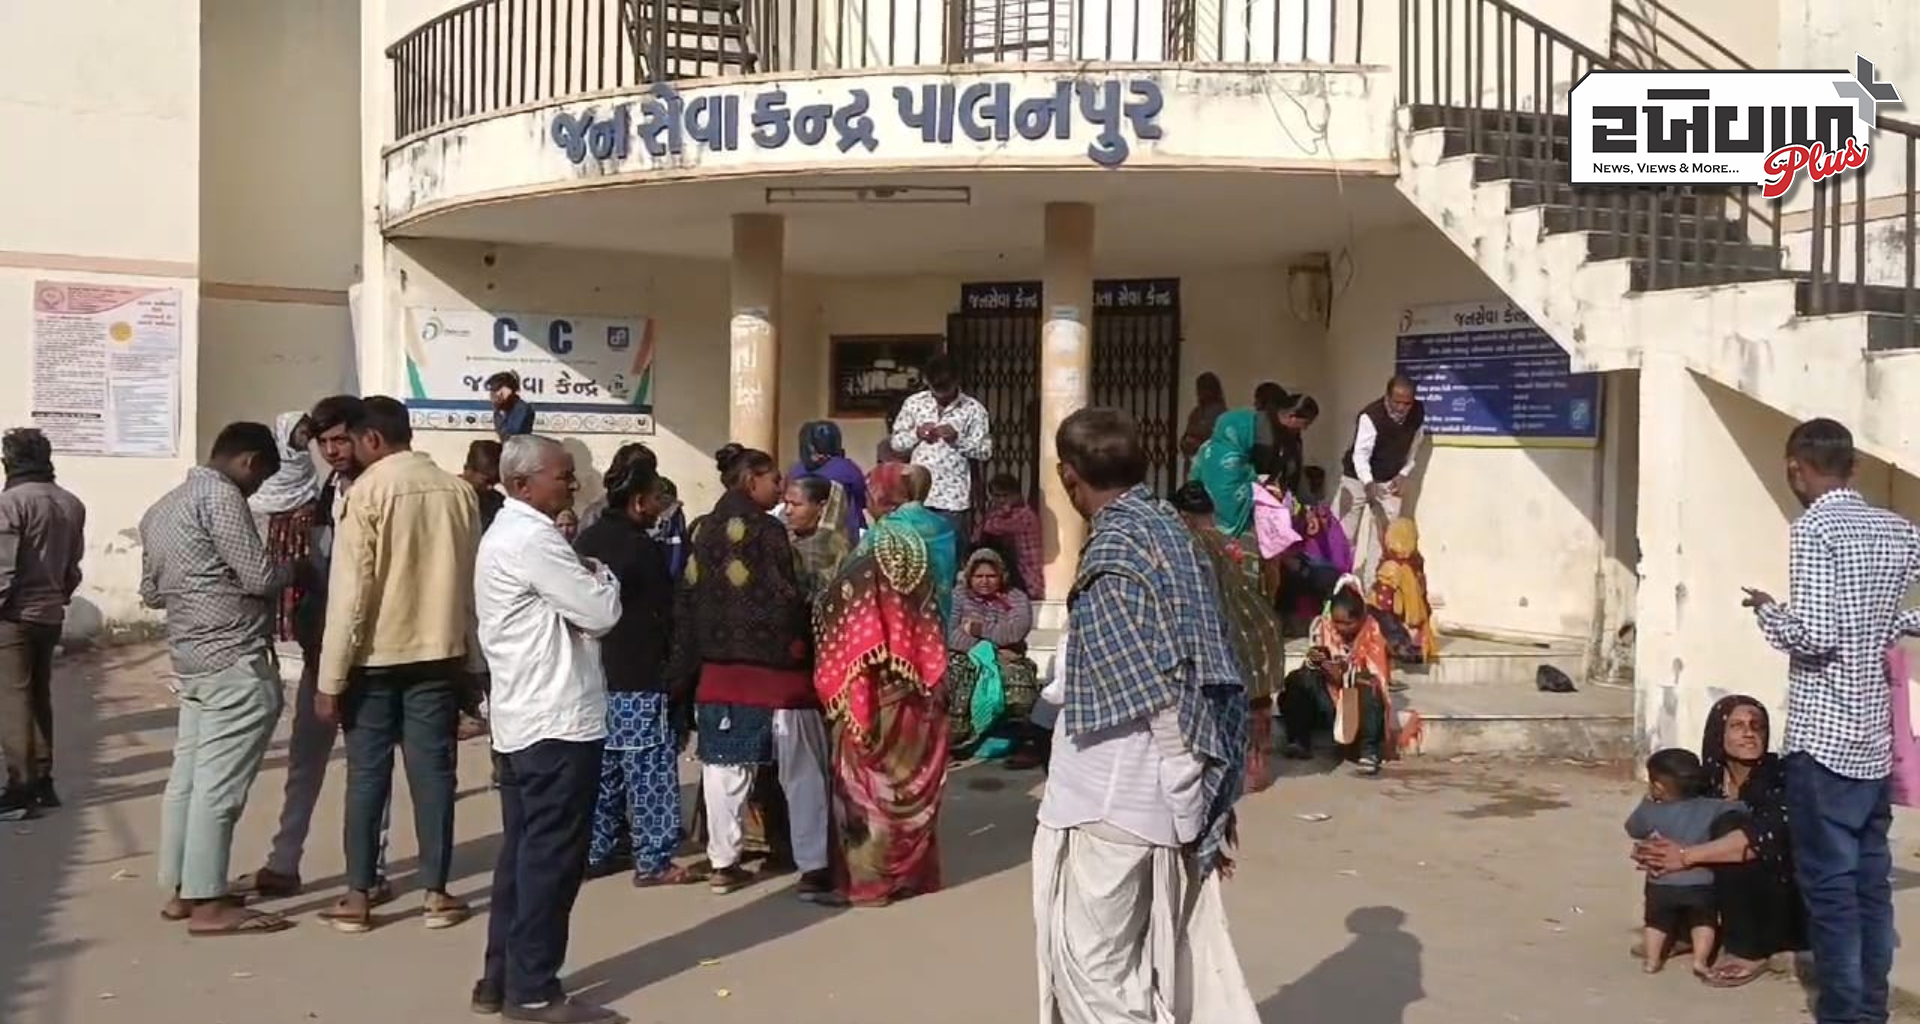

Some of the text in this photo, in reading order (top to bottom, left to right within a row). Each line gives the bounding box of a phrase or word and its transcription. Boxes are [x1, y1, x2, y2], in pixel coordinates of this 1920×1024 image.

[551, 104, 629, 164] જન
[638, 82, 739, 157] સેવા
[892, 79, 1164, 167] પાલનપુર
[554, 371, 599, 396] કેન્દ્ર
